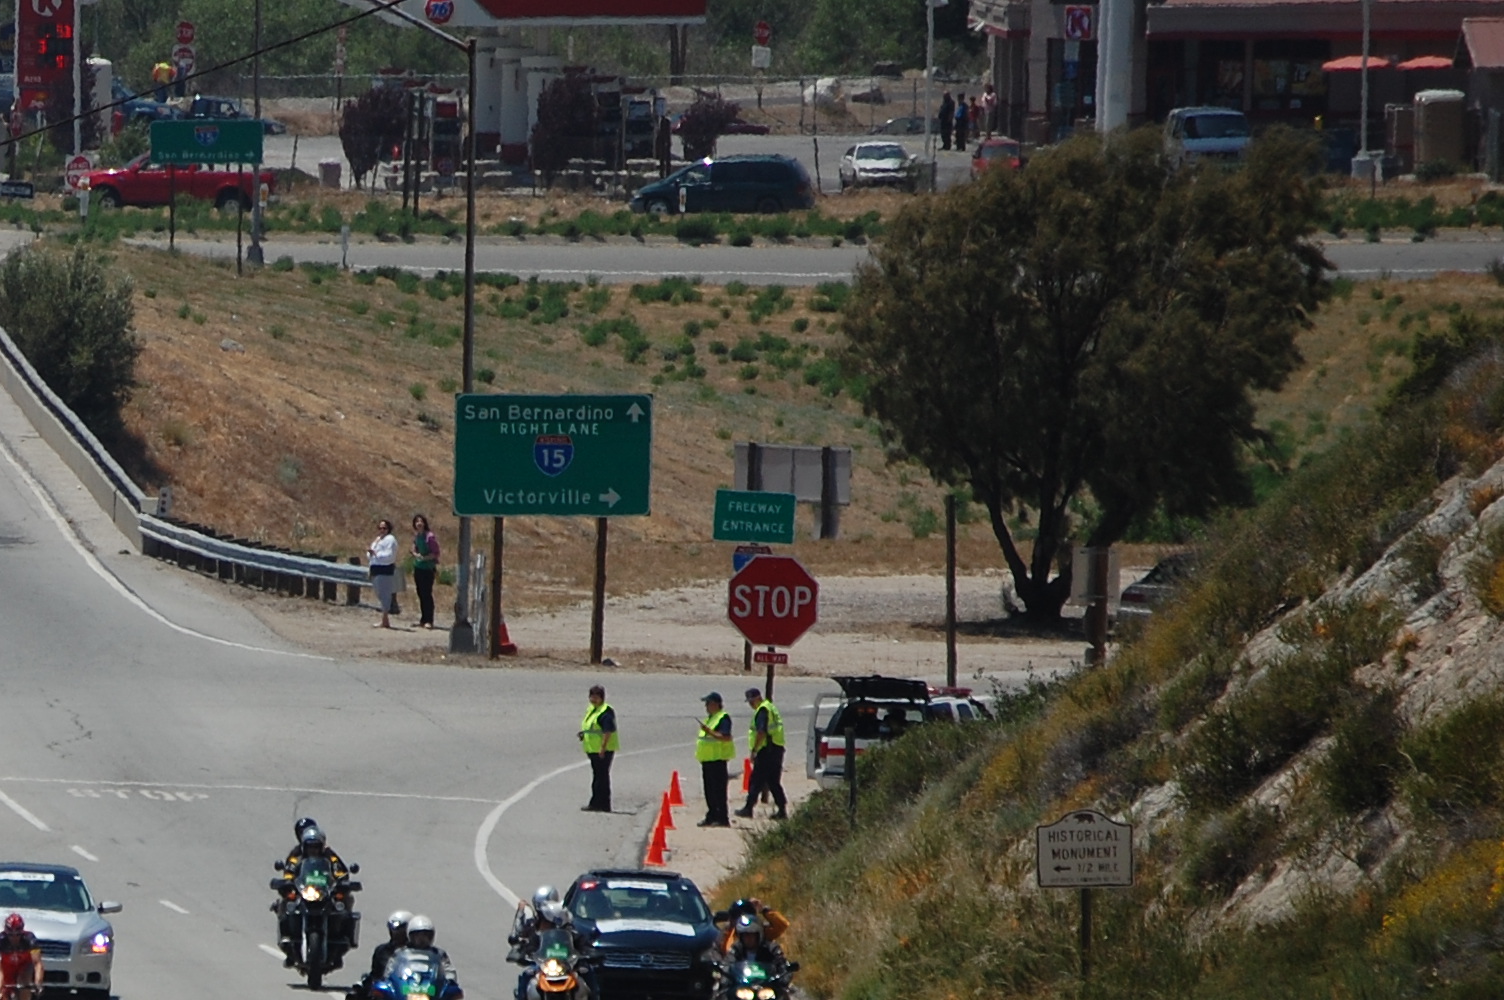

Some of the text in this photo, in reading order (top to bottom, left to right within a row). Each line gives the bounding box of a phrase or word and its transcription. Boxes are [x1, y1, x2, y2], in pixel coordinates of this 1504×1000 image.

[464, 404, 614, 421] San Bernardino
[500, 422, 599, 435] RIGHT LANE
[542, 448, 566, 468] 15
[483, 488, 591, 505] Victorville
[728, 500, 783, 514] FREEWAY
[722, 520, 785, 534] ENTRANCE
[733, 584, 812, 618] STOP
[756, 654, 770, 662] ALL
[1048, 829, 1121, 843] HISTORICAL
[1051, 846, 1118, 860] MONUMENT
[1077, 862, 1120, 873] 1/2 MILE
